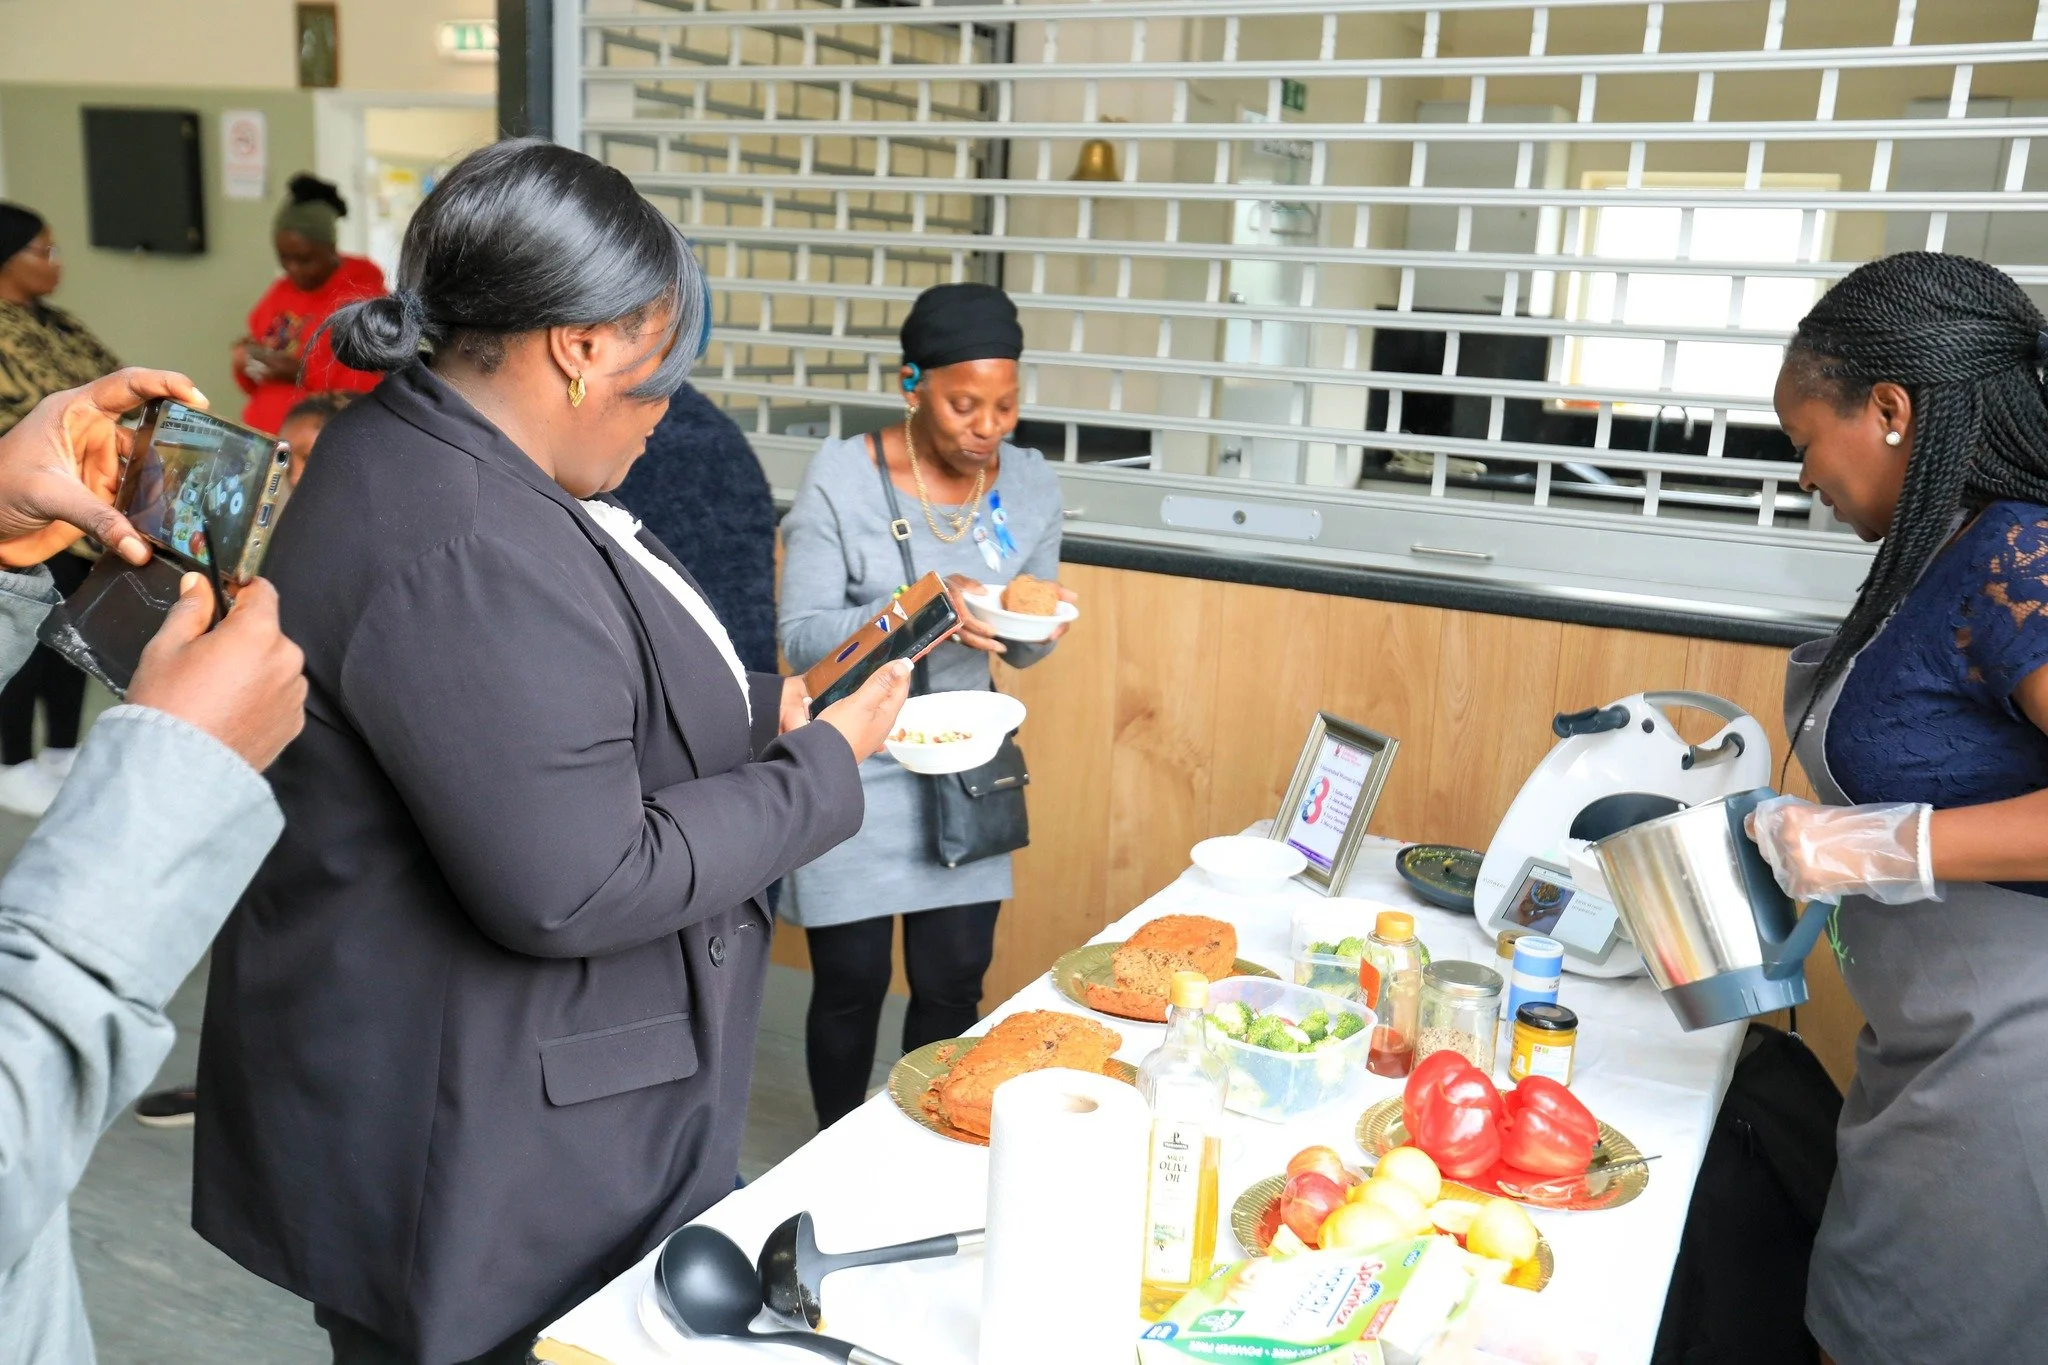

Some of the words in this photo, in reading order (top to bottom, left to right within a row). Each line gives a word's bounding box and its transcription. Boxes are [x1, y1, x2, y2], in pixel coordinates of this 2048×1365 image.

[1159, 1160, 1189, 1173] OLIVE
[1165, 1171, 1181, 1183] OIL
[1188, 1340, 1214, 1355] FREE
[1215, 1343, 1263, 1358] POWDER
